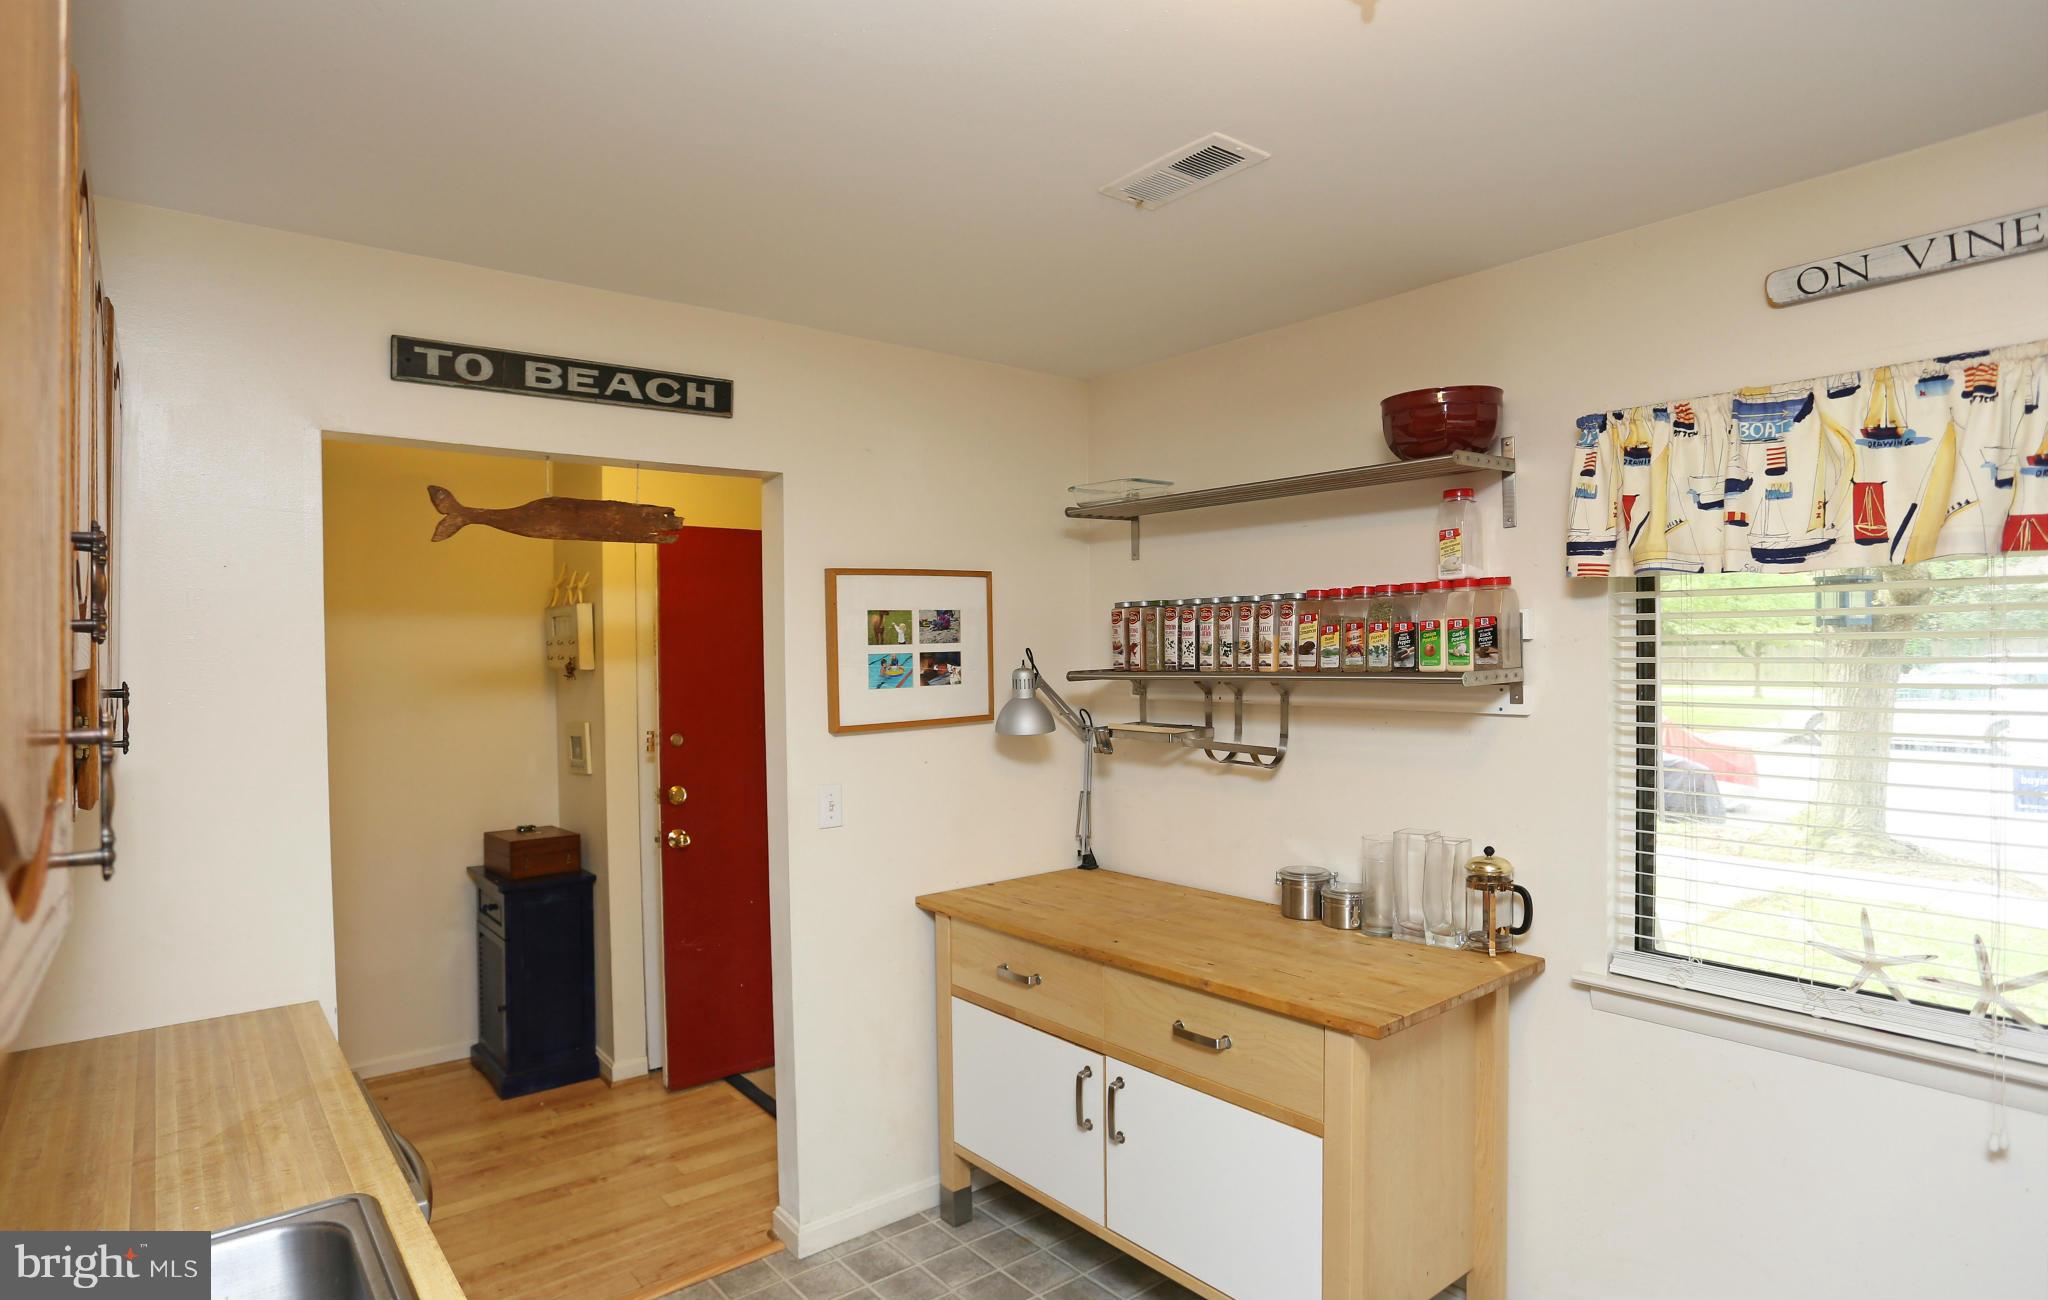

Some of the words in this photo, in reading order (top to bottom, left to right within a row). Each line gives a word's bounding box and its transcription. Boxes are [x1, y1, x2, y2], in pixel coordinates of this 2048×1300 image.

[1796, 254, 1870, 294] ON
[1899, 212, 2046, 270] VINE
[413, 346, 494, 382] TO
[523, 360, 716, 409] BEACH
[1739, 419, 1794, 439] BOAT
[1867, 438, 1915, 449] DRAWING
